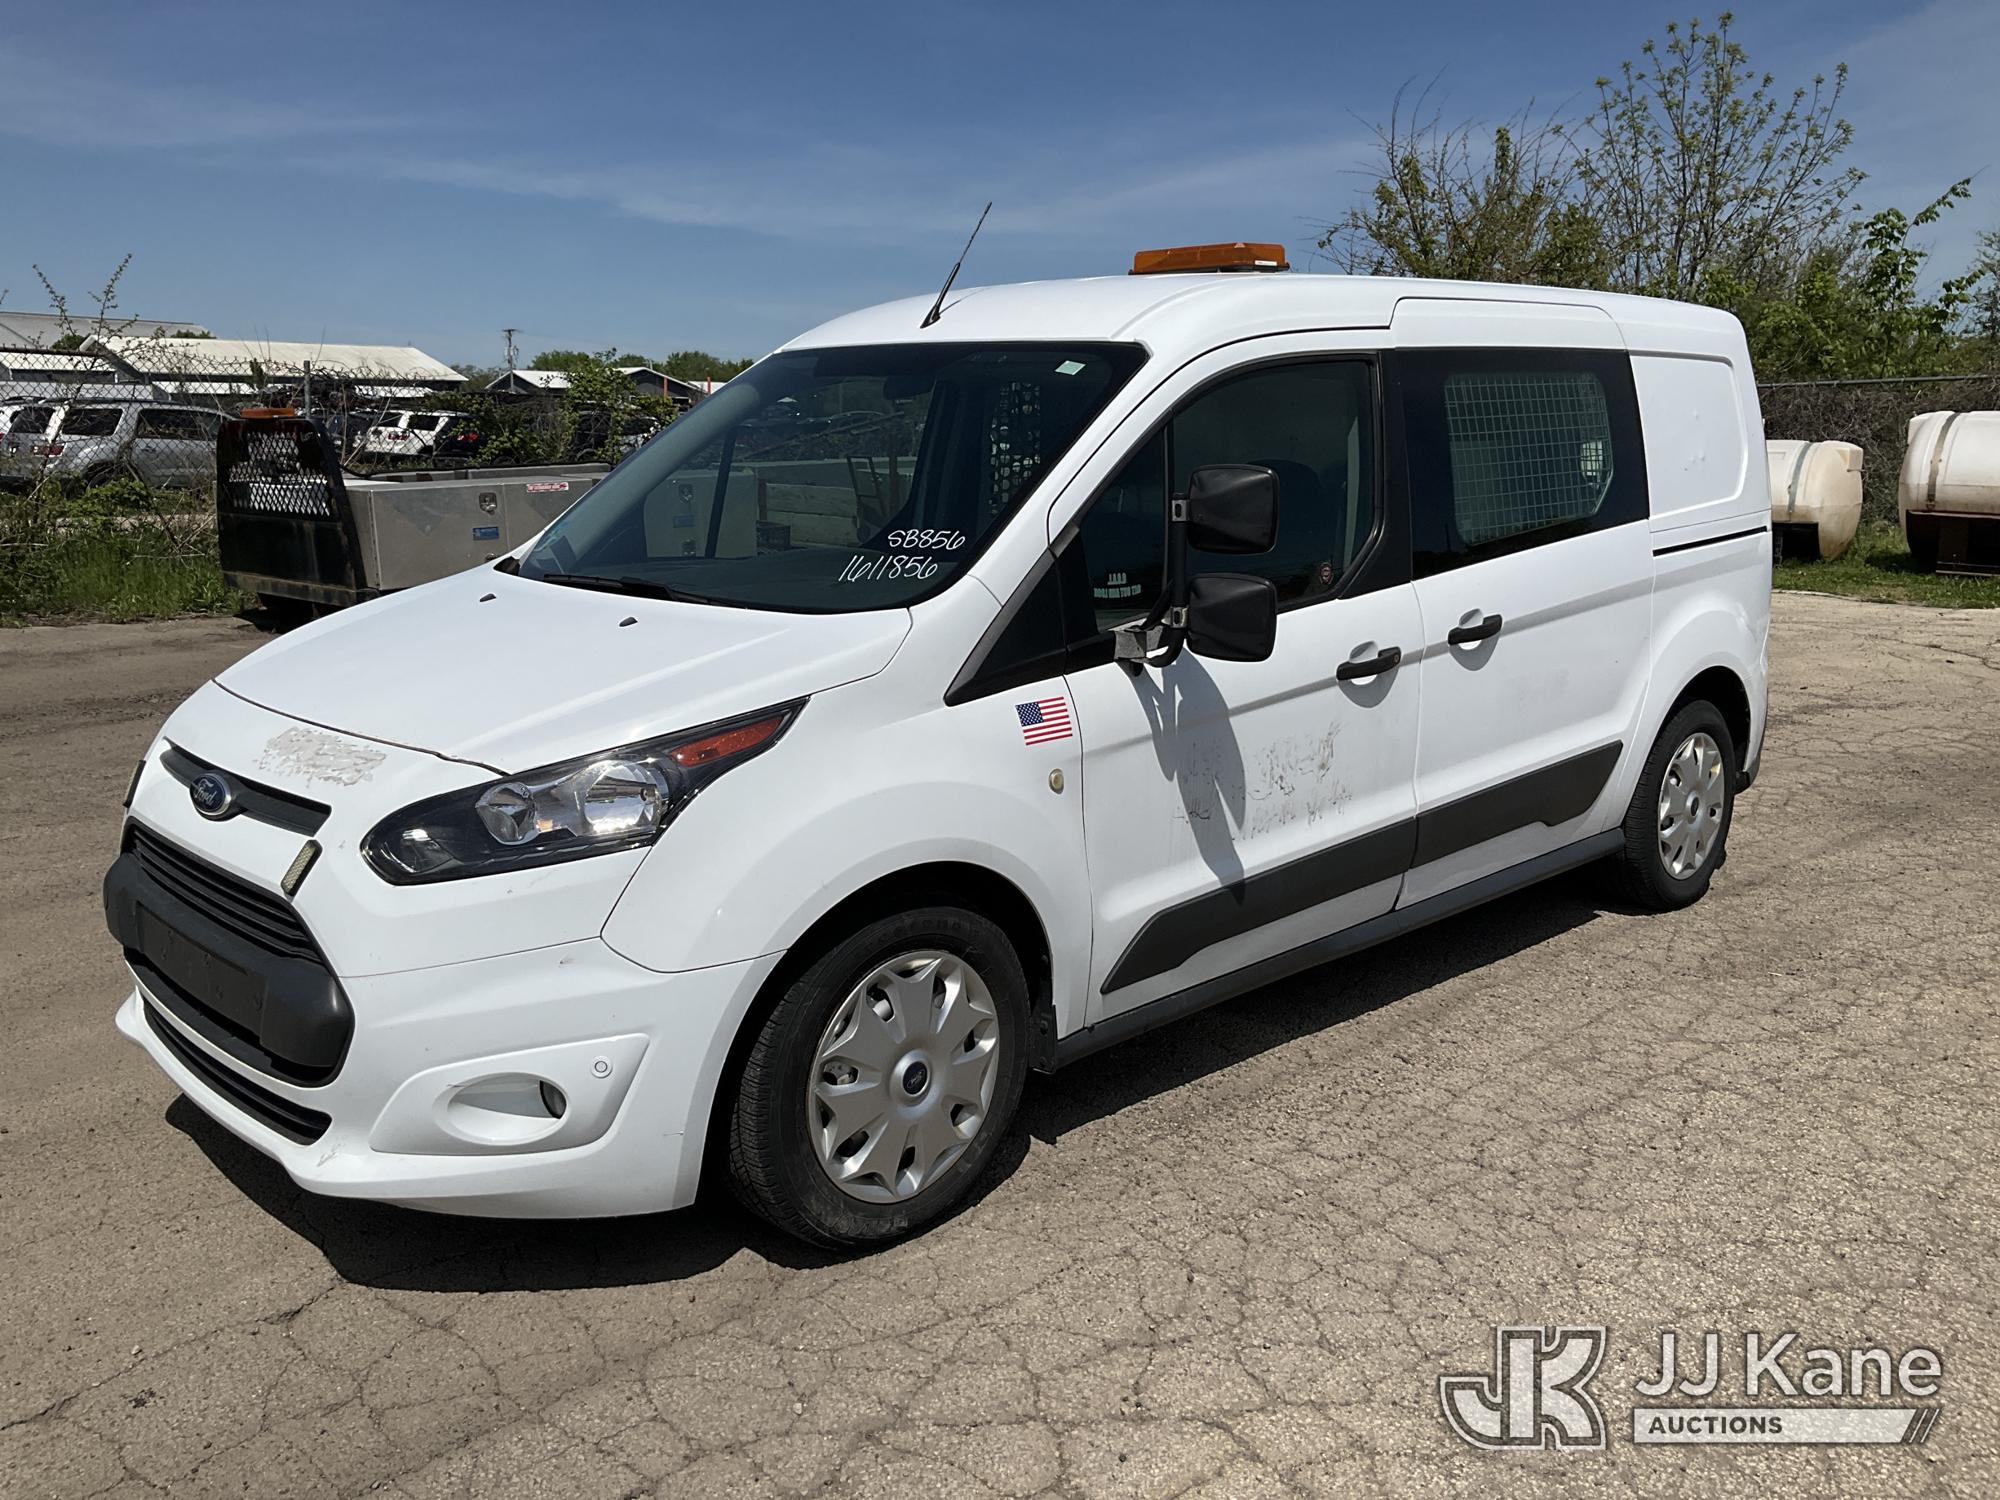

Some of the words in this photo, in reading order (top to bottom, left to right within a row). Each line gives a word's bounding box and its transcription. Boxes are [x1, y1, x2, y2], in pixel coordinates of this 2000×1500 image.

[888, 529, 966, 550] SB856
[838, 555, 938, 582] 1611856
[193, 778, 217, 806] Ford
